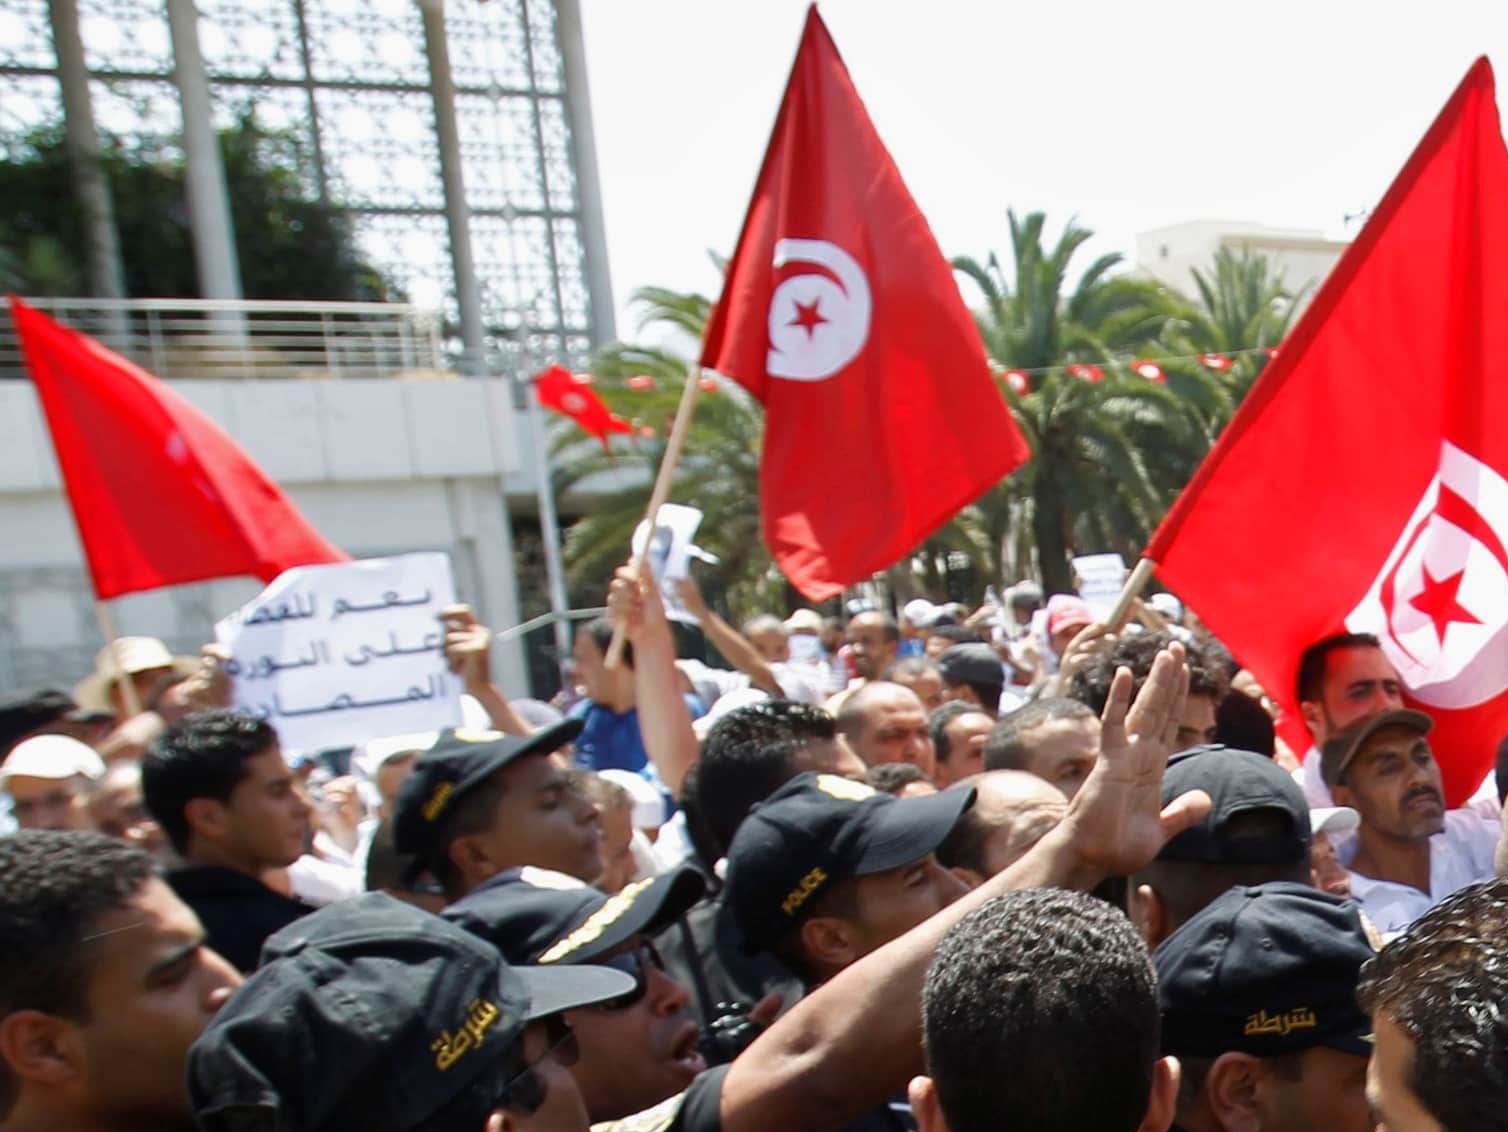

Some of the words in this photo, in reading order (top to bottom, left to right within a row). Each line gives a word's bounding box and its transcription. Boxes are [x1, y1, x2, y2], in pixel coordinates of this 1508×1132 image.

[781, 866, 828, 917] POLICE
[430, 997, 499, 1071] شرطة
[1244, 1007, 1317, 1037] شرطة
